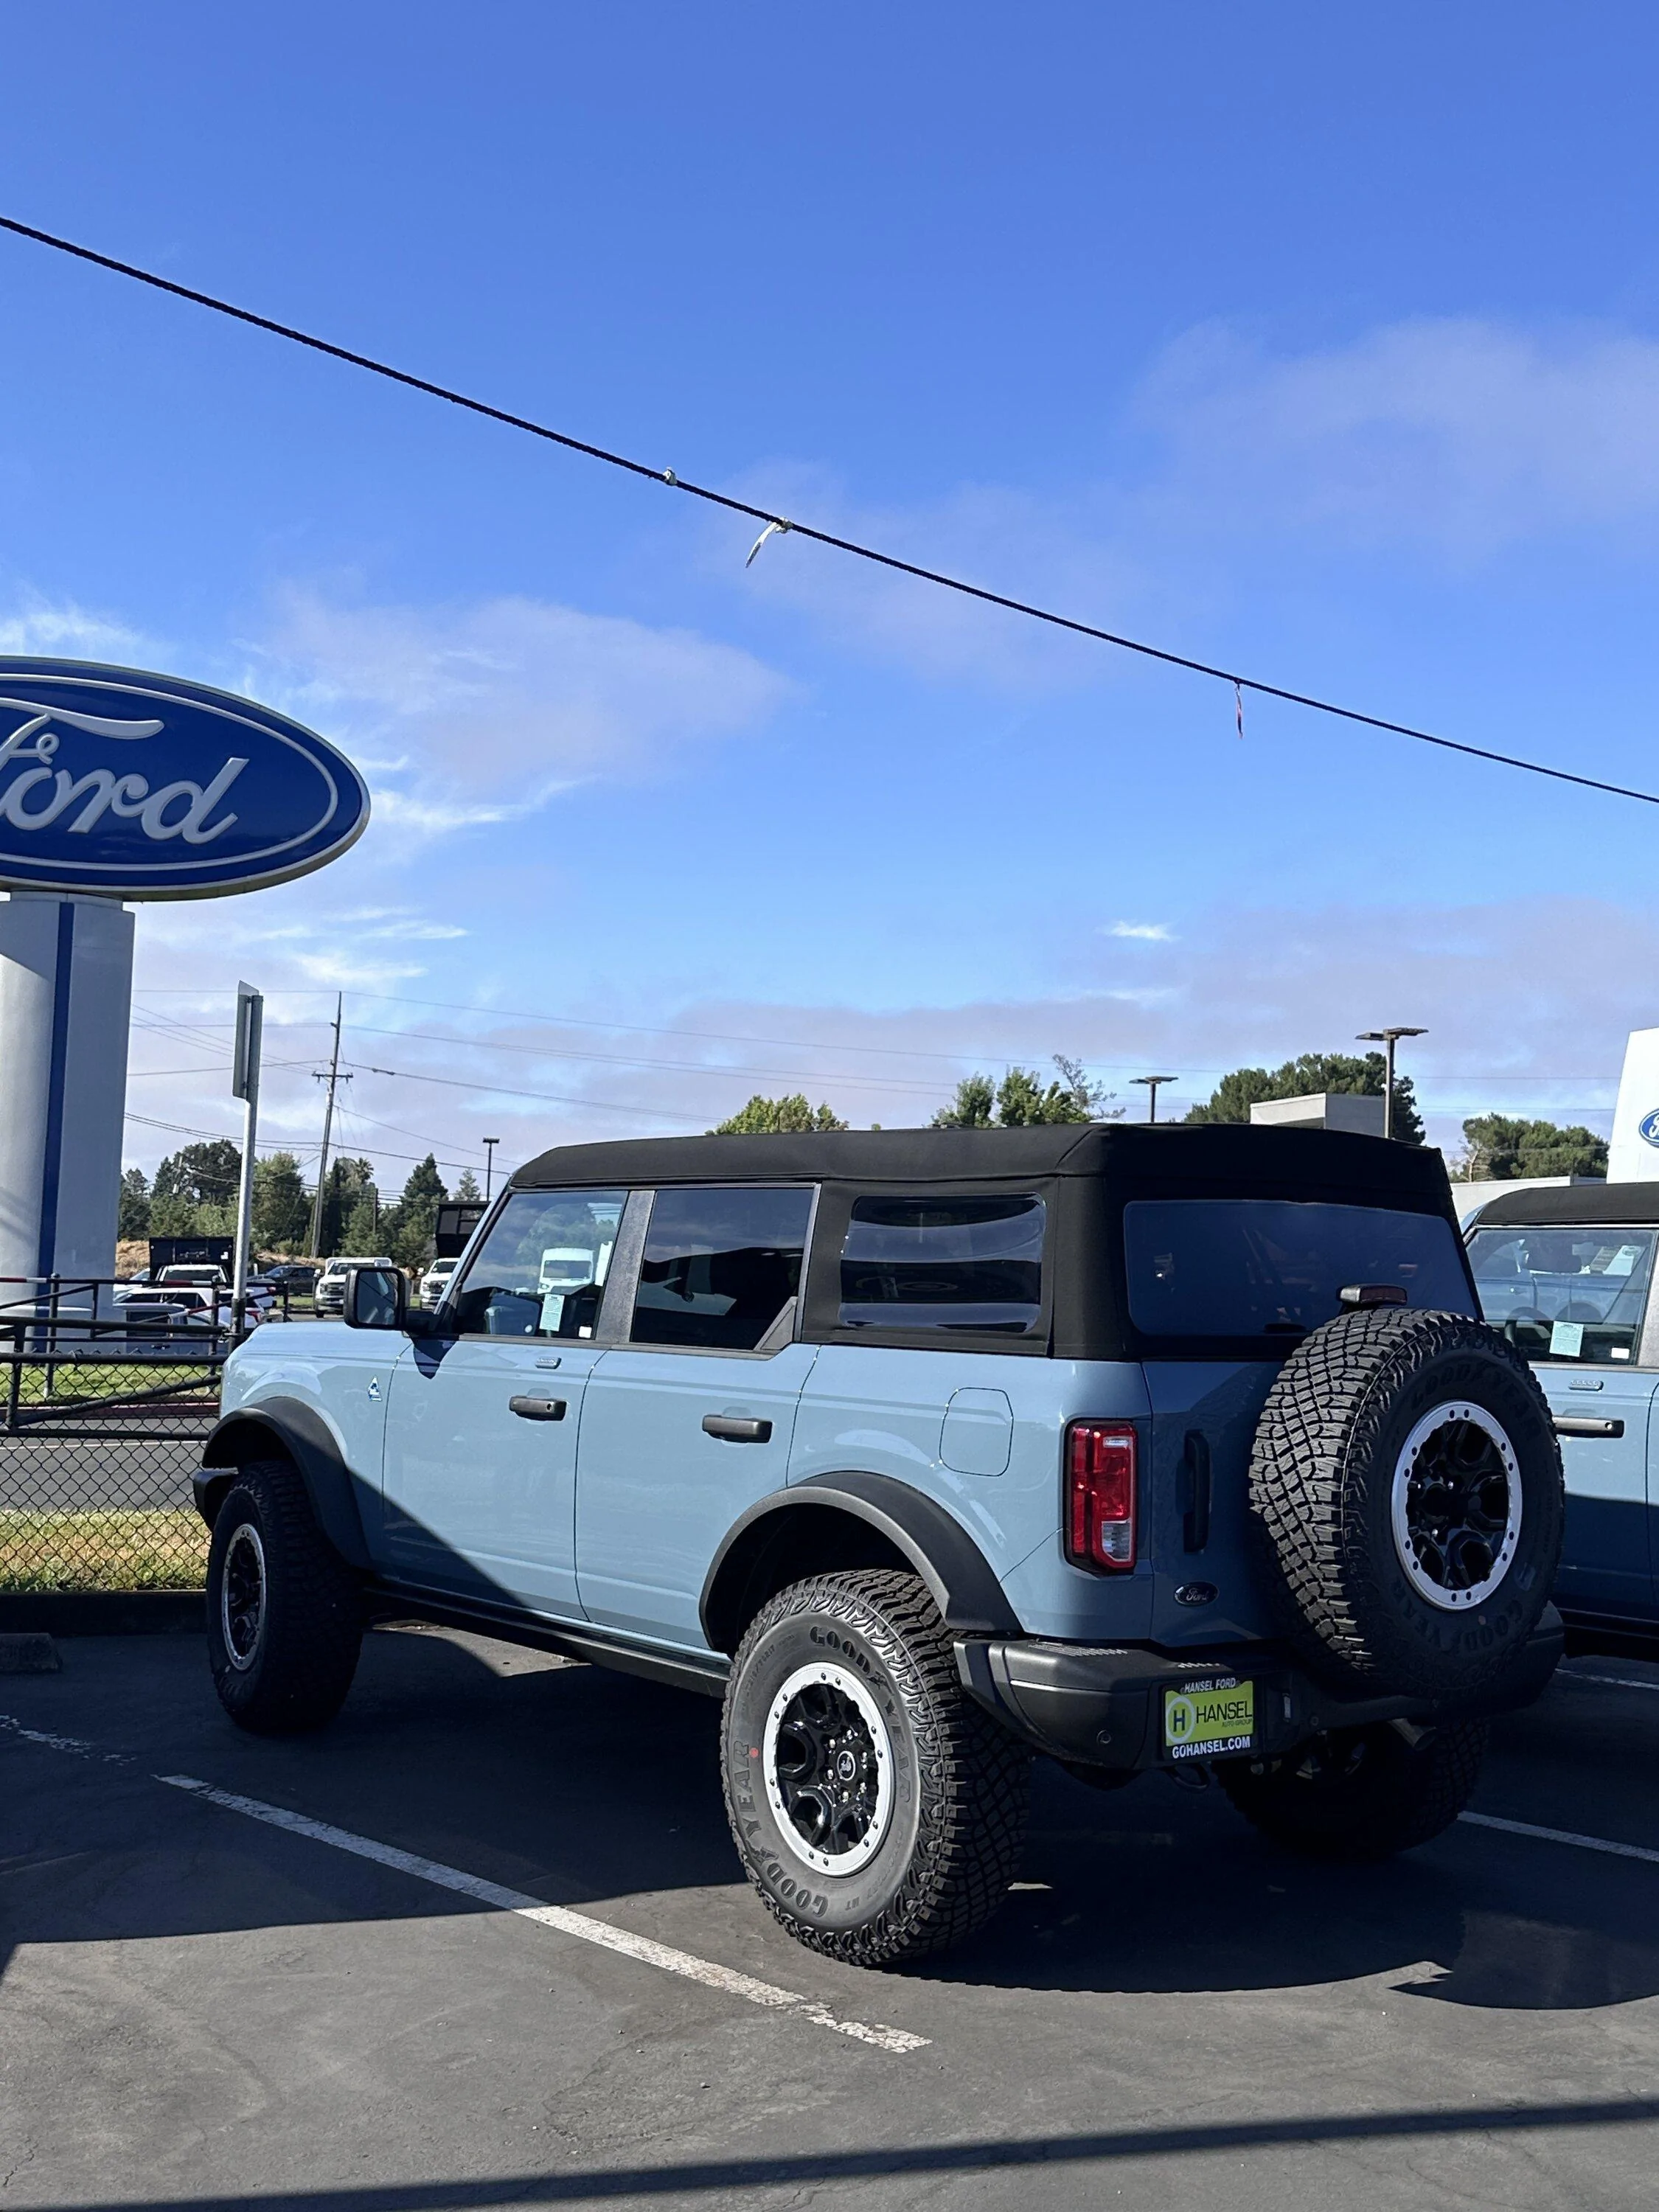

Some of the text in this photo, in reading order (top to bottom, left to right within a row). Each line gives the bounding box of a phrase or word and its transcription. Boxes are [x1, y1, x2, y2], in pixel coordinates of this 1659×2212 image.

[1186, 1587, 1209, 1601] Ford
[1184, 1677, 1237, 1694] HANSEL FORD
[1173, 1708, 1186, 1733] H
[1196, 1700, 1253, 1724] HANSEL
[1235, 1718, 1253, 1726] GROUP
[1172, 1735, 1251, 1759] GOHANSEL.COM
[732, 1739, 829, 1919] GOODYEAR
